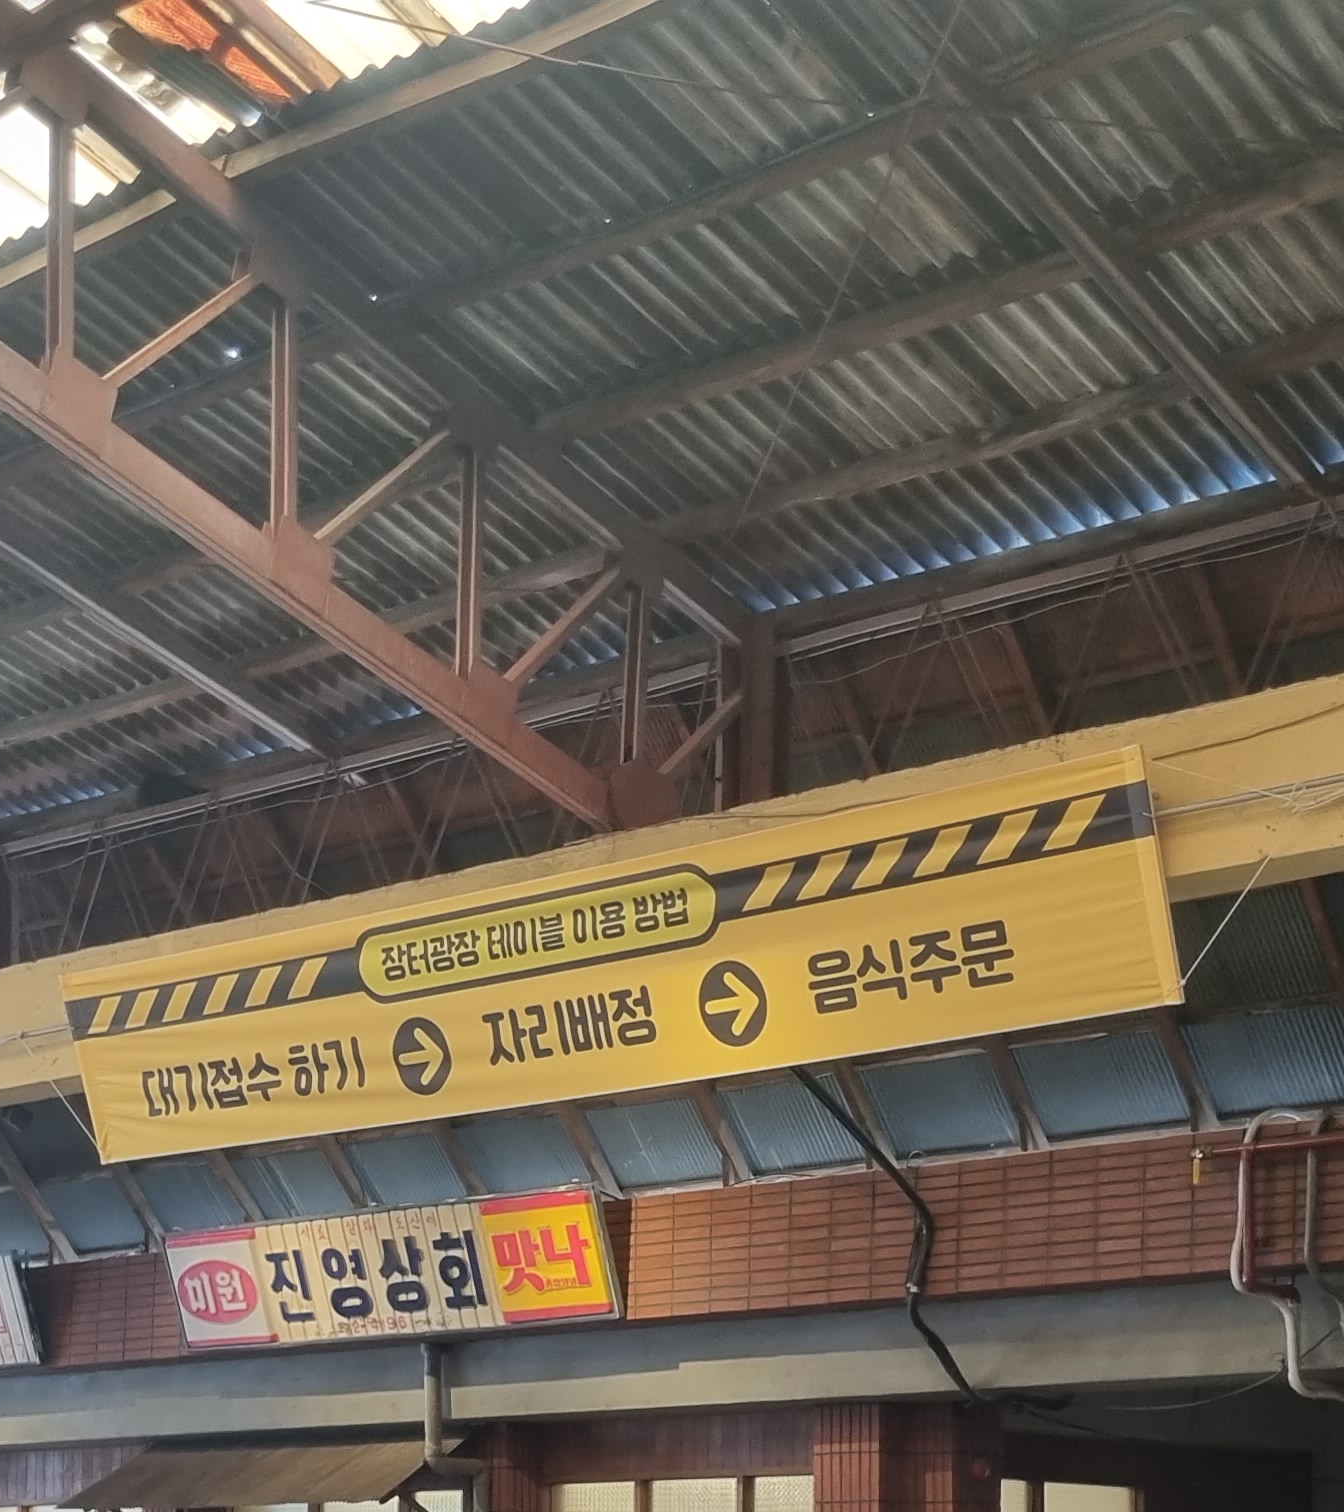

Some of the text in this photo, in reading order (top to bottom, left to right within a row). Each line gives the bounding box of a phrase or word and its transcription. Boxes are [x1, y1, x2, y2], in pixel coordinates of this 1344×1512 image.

[381, 888, 689, 980] 장터광장 테이블 이용 방법
[807, 920, 1014, 1015] 음식주문
[482, 985, 657, 1066] 자리배정
[141, 1037, 365, 1118] 대기접수 하기
[183, 1268, 247, 1315] 미원
[265, 1229, 489, 1322] 진영상회
[492, 1223, 591, 1294] 맛나
